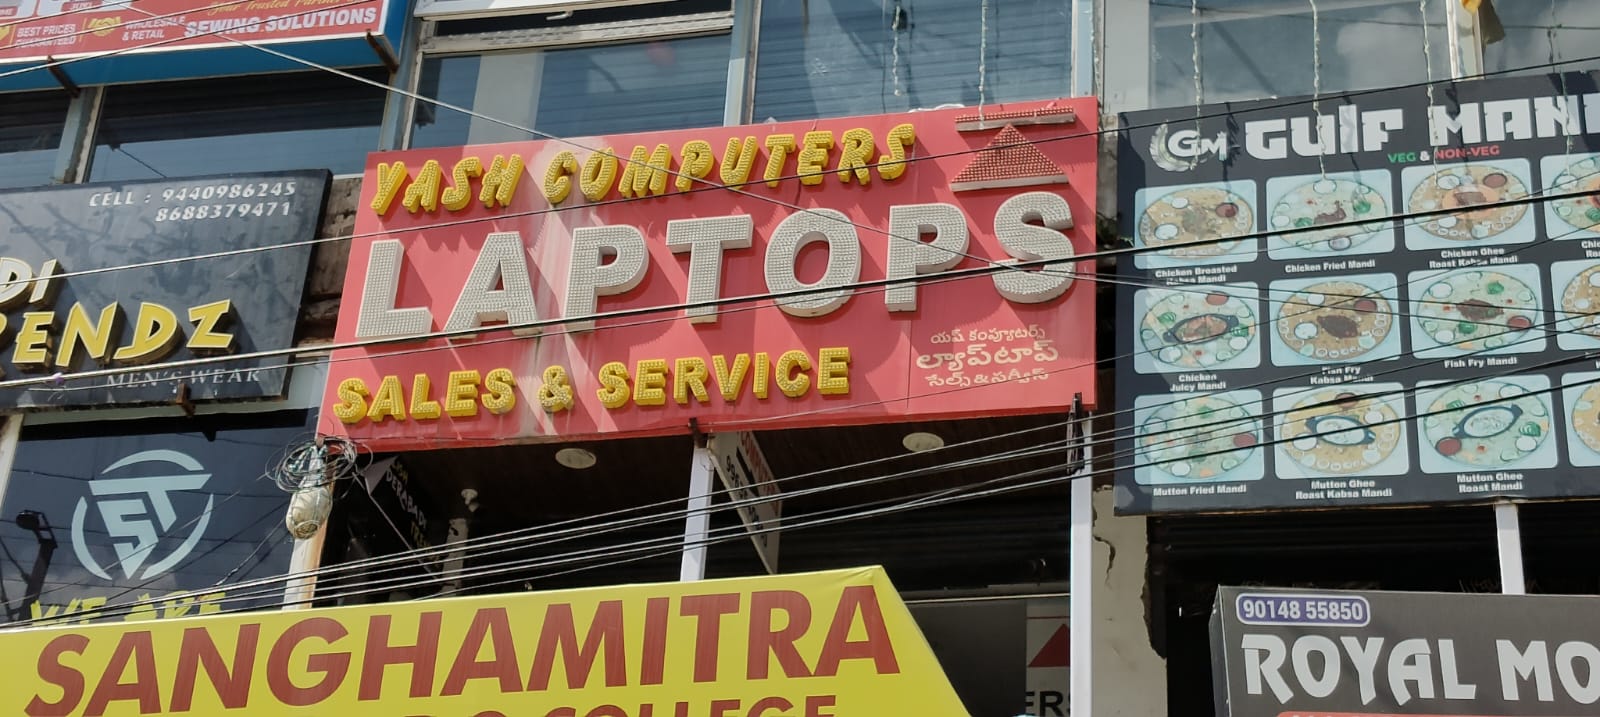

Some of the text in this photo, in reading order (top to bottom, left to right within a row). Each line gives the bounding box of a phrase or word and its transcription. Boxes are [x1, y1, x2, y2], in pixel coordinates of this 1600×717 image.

[184, 7, 377, 38] SEWING SOLUTIONS
[16, 24, 76, 38] BEST PRICES
[122, 30, 165, 41] & RETAIL
[1388, 145, 1500, 163] VEG & NON-VEG
[371, 123, 915, 216] YASH COMPUTERS
[89, 191, 135, 207] CELL
[162, 182, 296, 202] 9440986245
[155, 202, 290, 222] 8688379471
[1441, 247, 1505, 258] Chicken Ghee
[355, 191, 1076, 341] LAPTOPS
[1285, 259, 1375, 273] Chicken Fried Mandi
[1429, 259, 1456, 268] Roast
[1490, 255, 1518, 265] Mandi
[1155, 269, 1192, 278] Chicken
[1198, 275, 1226, 284] Mandi
[0, 299, 234, 367] ENDZ
[1444, 356, 1518, 368] Fish Fry Mandi
[191, 369, 261, 385] WEAR
[1345, 366, 1361, 375] Fry
[1178, 373, 1217, 383] Chicken
[1310, 375, 1342, 385] Kabsa
[333, 346, 852, 424] SALES & SERVICE
[1170, 381, 1226, 392] Juicy Mandi
[1311, 479, 1376, 489] Mutton Ghee
[1456, 472, 1524, 483] Mutton Ghee
[1153, 484, 1247, 496] Mutton Fried Mandi
[1459, 481, 1523, 493] Roast Mandi
[1295, 488, 1393, 500] Roast Kabsa Mandi
[1242, 599, 1364, 621] 90148 55850
[24, 585, 901, 717] SANGHAMITRA
[1241, 634, 1477, 706] ROYAL
